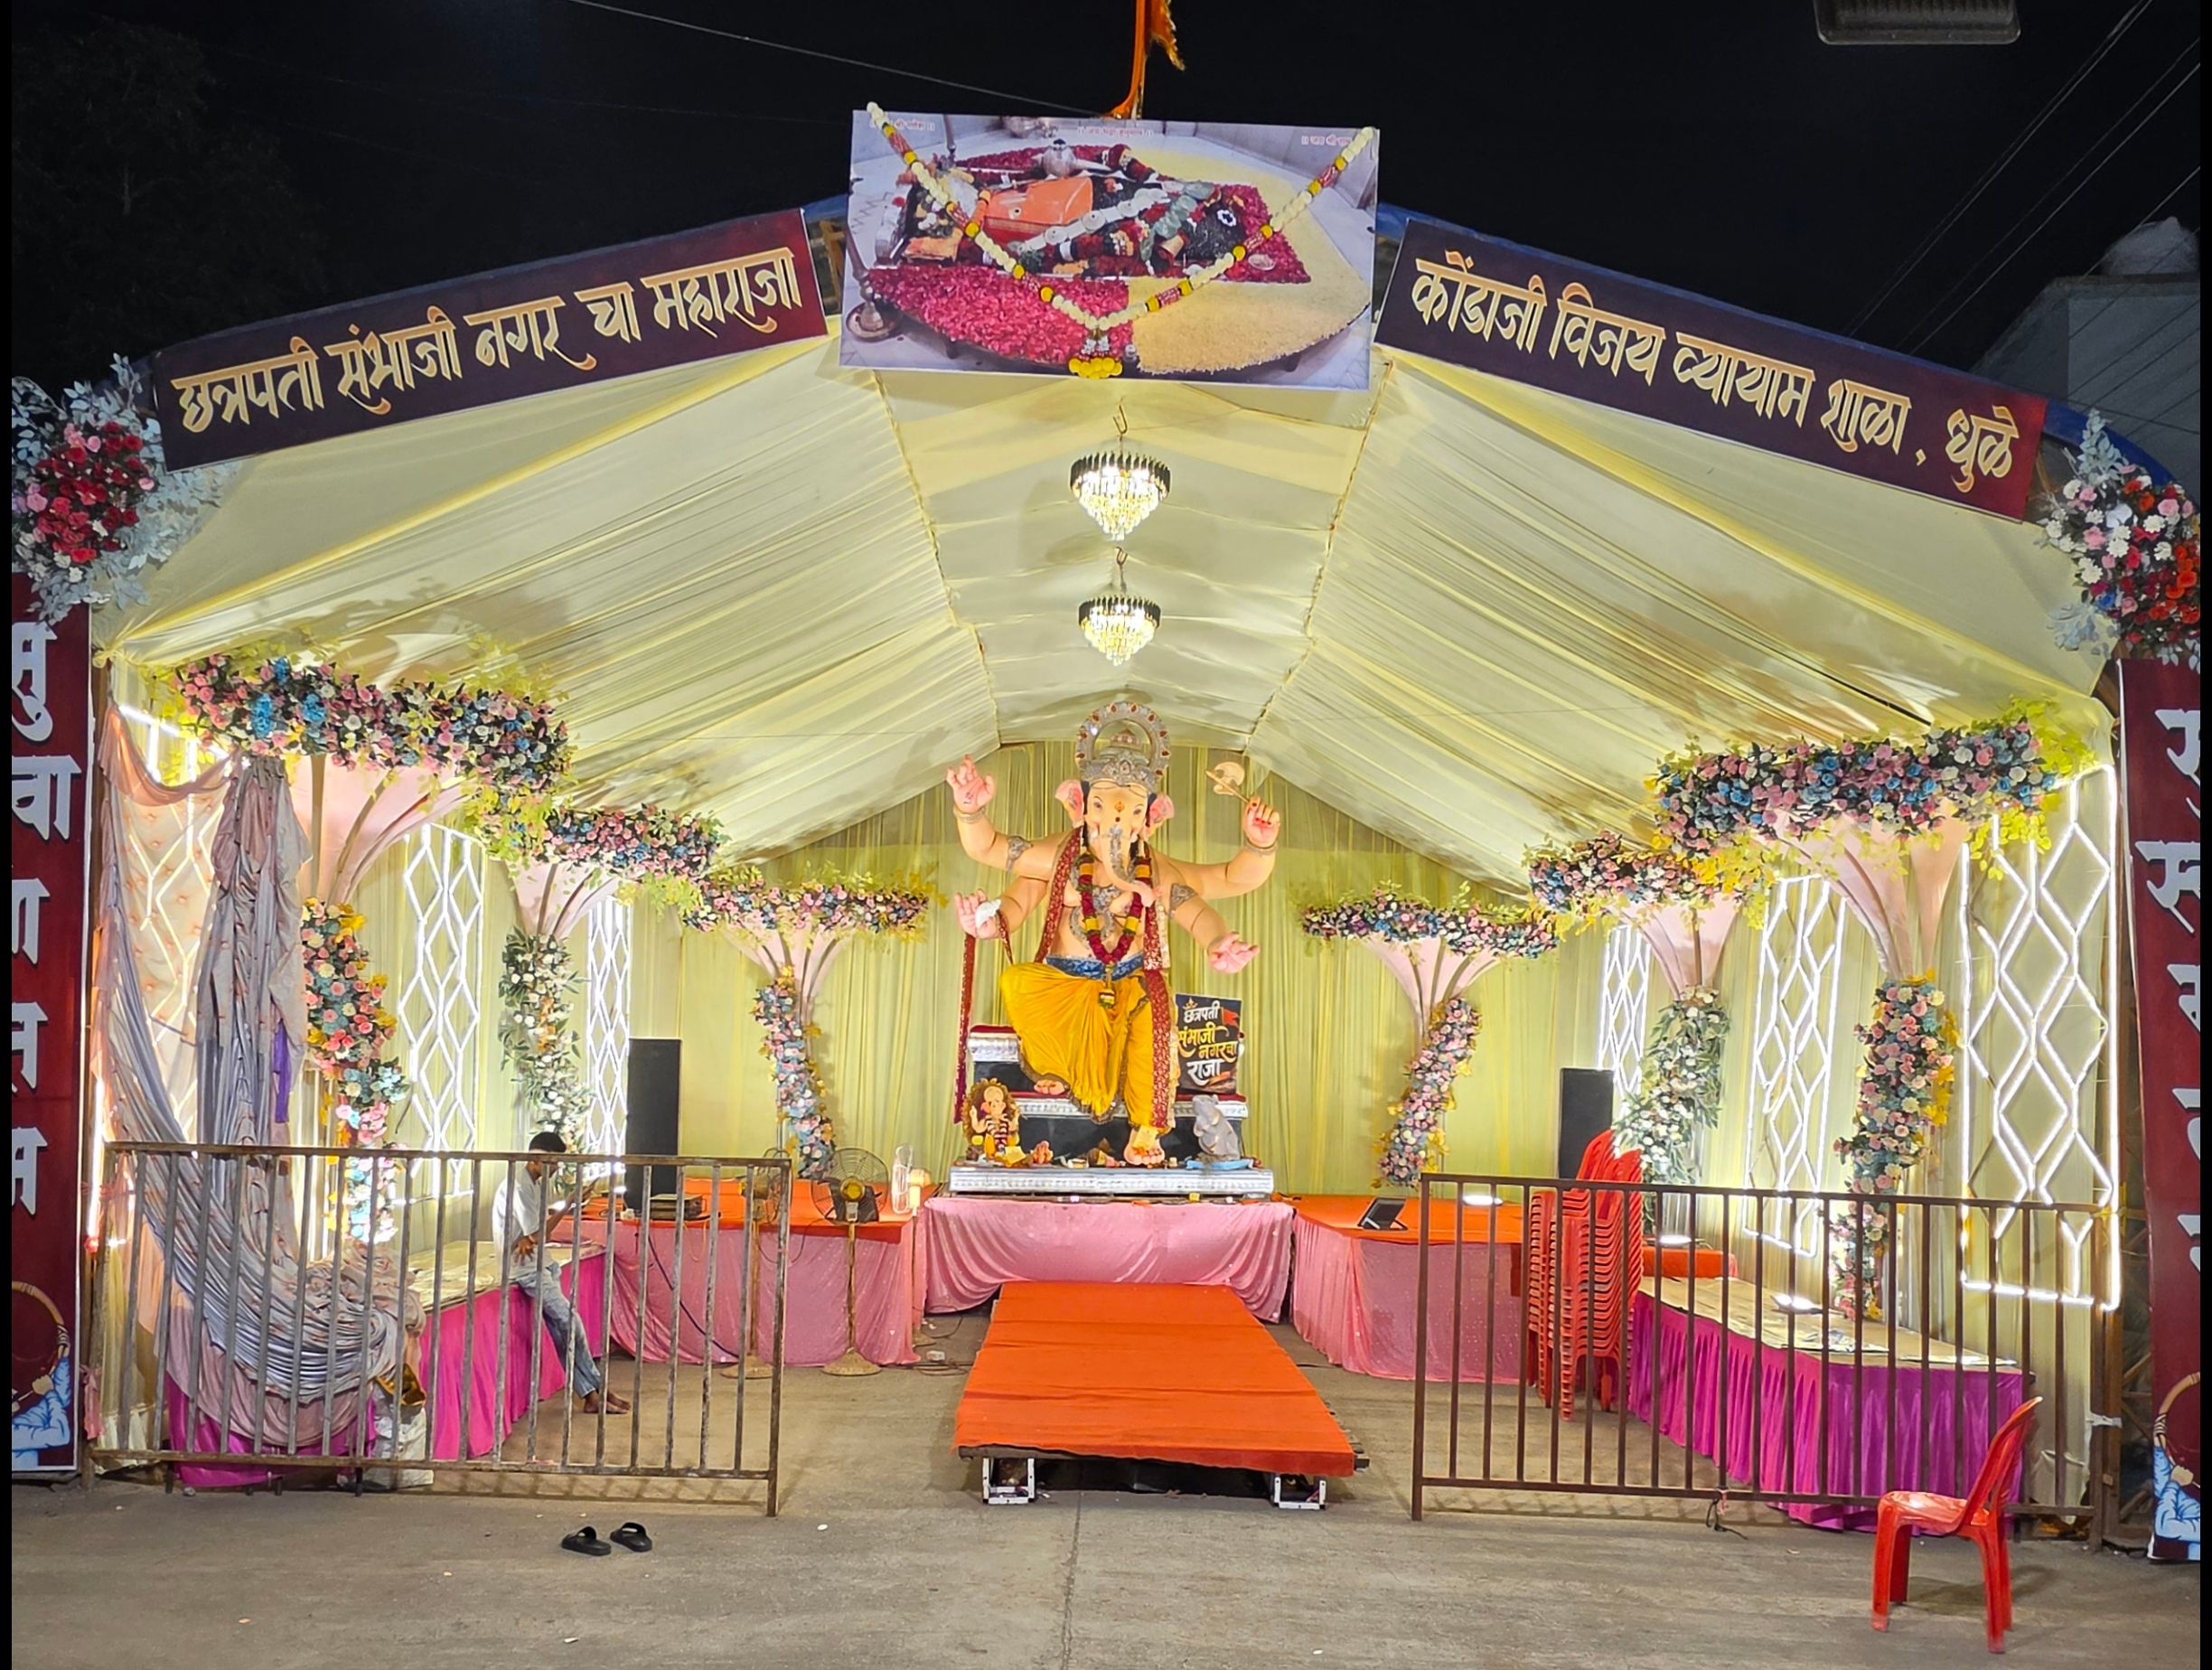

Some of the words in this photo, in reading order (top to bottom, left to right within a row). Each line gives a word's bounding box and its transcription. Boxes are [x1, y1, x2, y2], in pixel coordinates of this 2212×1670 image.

[172, 336, 324, 433] छत्रपती
[323, 305, 463, 415] संभाजी
[463, 296, 596, 371] नगर
[574, 281, 642, 343] चा
[640, 246, 802, 339] महाराजा
[1548, 282, 1667, 386] विजय
[1672, 331, 1816, 427] व्यायाम
